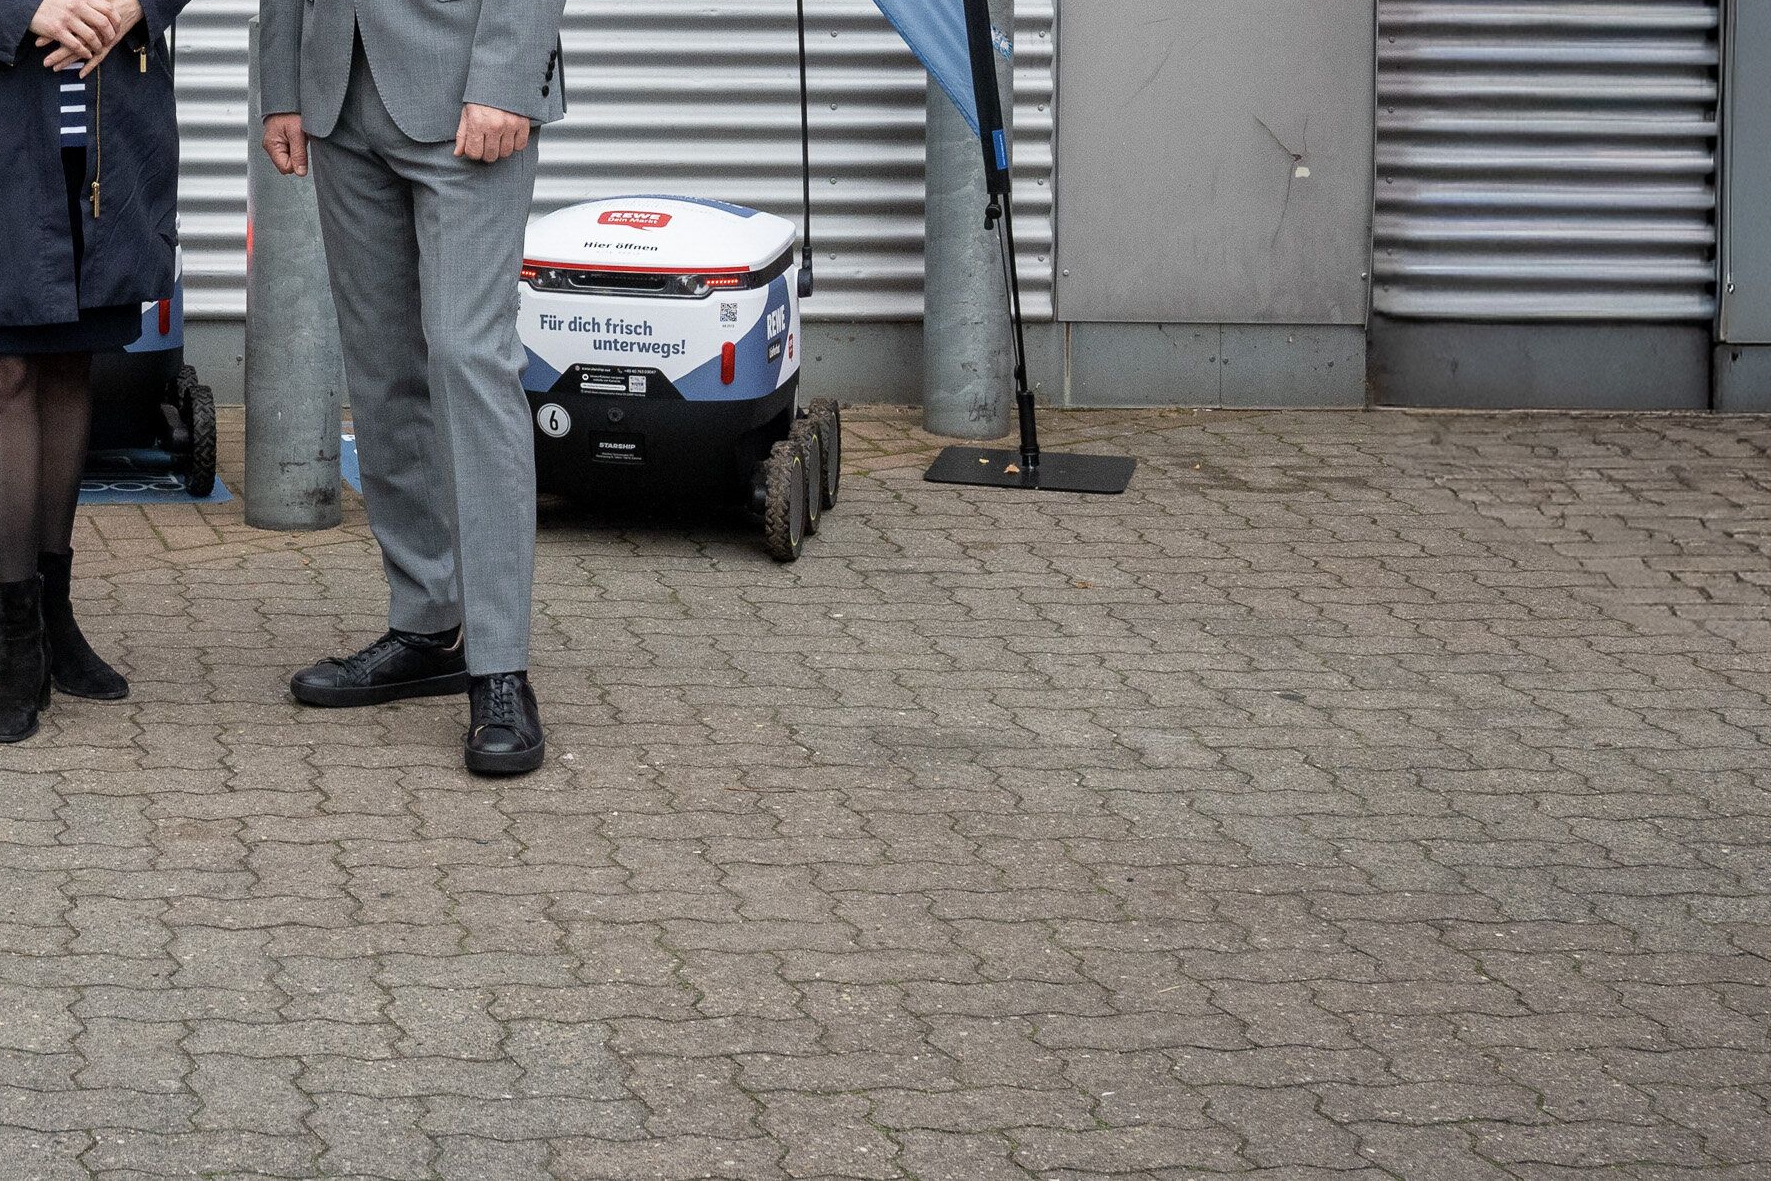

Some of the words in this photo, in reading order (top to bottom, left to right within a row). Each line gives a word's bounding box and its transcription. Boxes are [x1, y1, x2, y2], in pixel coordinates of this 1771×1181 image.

[609, 212, 661, 220] REWE
[583, 241, 612, 249] Hier
[615, 242, 658, 252] öffnen
[539, 314, 566, 332] Für
[568, 316, 601, 333] dich
[604, 318, 653, 336] frisch
[766, 304, 786, 341] REWE
[593, 338, 686, 358] unterwegs!
[548, 410, 559, 432] 6
[599, 441, 636, 450] STARSHIP
